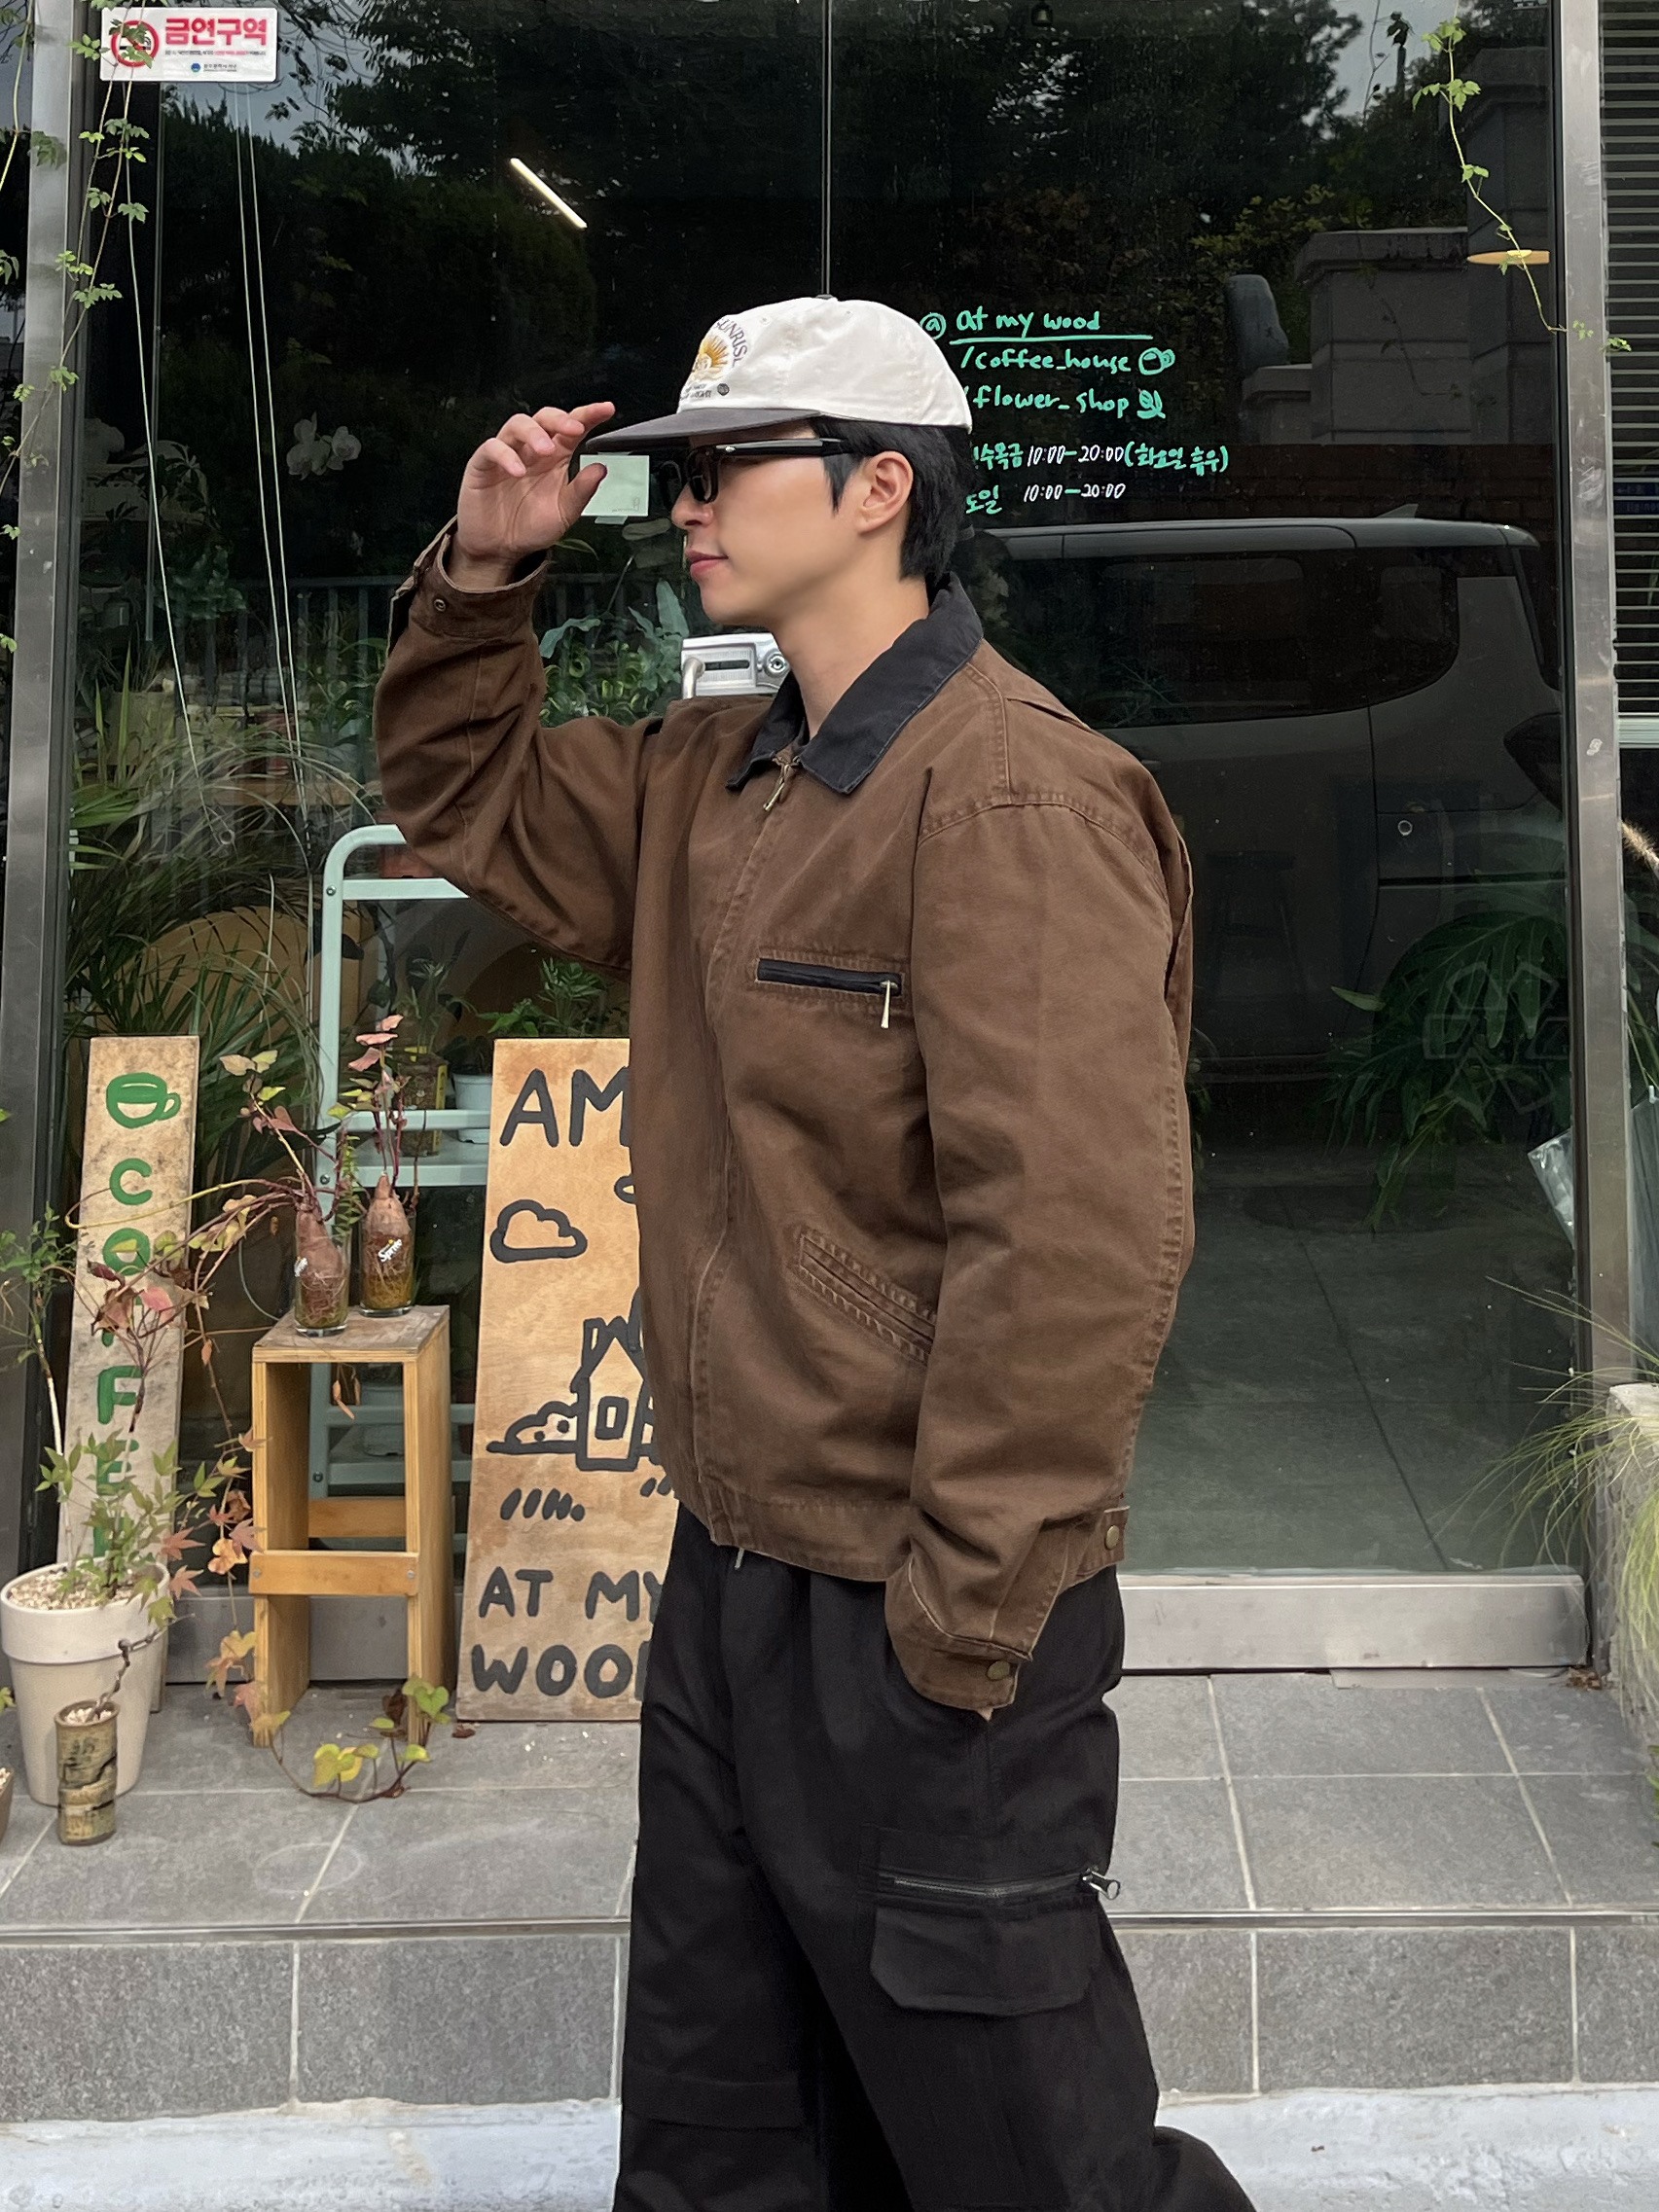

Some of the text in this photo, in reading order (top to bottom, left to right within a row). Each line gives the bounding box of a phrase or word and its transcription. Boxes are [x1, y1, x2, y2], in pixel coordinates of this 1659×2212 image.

[165, 18, 268, 46] 금연구역
[956, 305, 989, 332] at
[996, 310, 1034, 339] my
[1043, 310, 1100, 331] wood
[479, 1566, 554, 1619] AT
[471, 1641, 651, 1702] WOO
